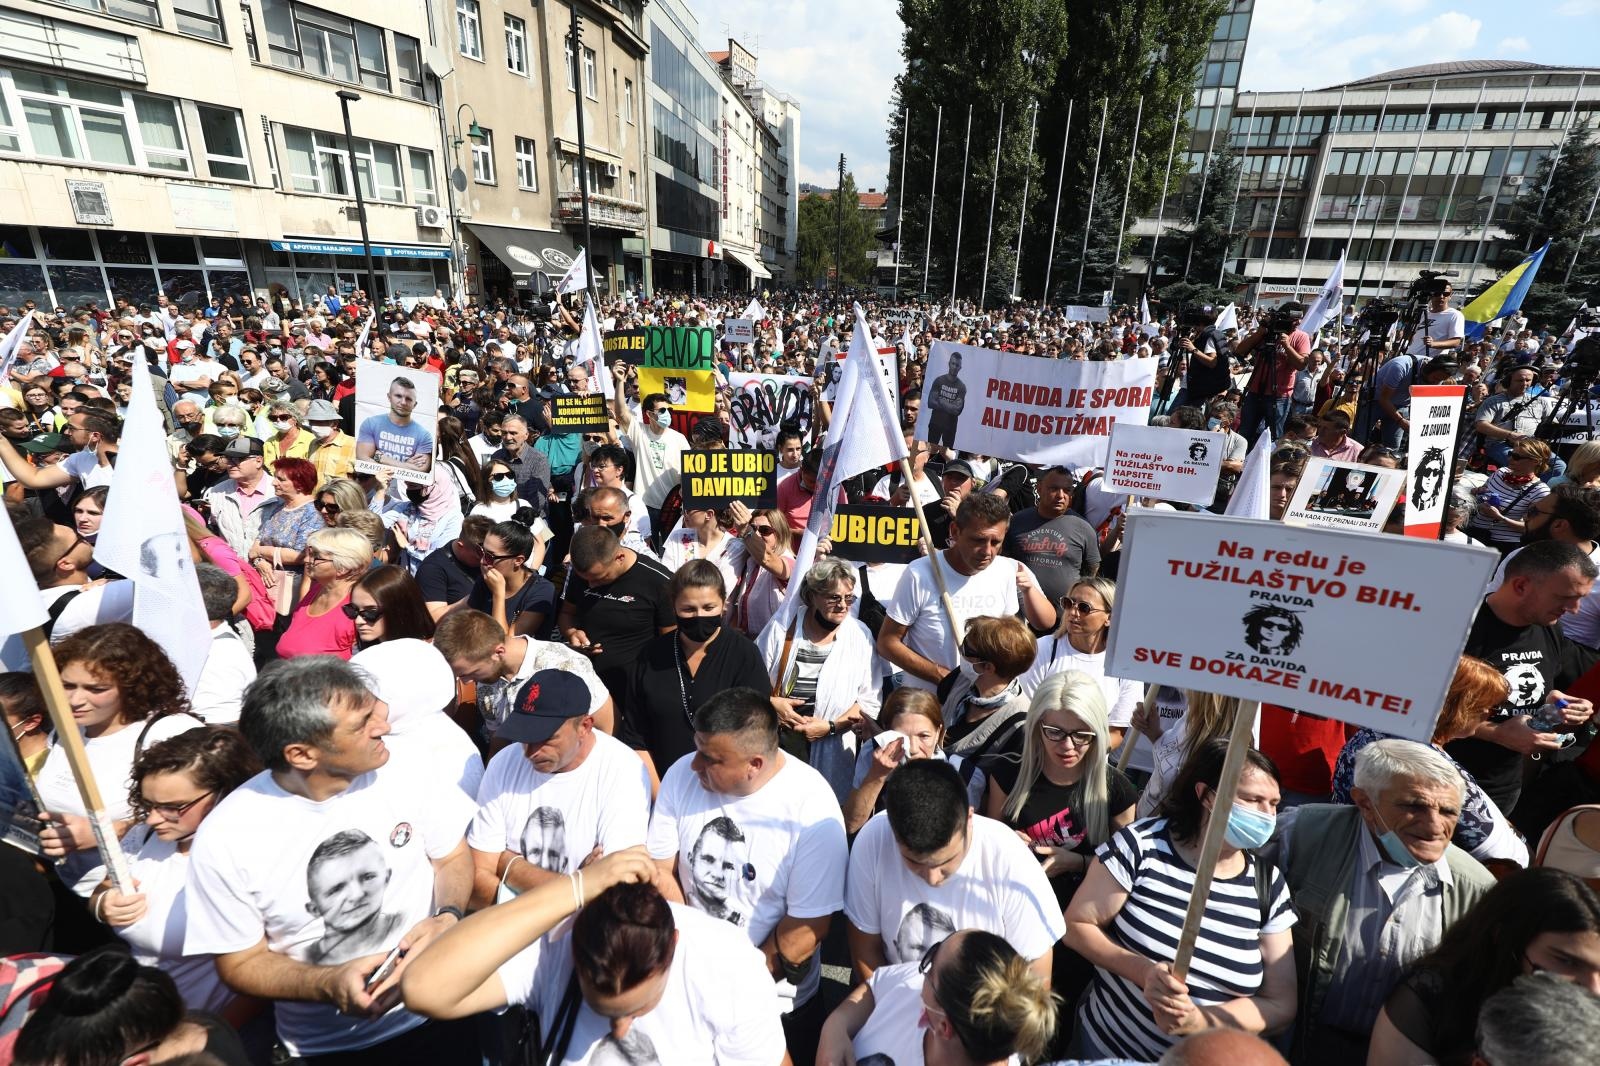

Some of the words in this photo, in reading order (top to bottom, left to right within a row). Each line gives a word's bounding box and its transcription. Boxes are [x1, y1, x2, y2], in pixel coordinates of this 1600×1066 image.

[630, 336, 645, 350] JE!
[986, 378, 1062, 408] PRAVDA
[1066, 389, 1087, 408] JE
[1089, 386, 1153, 408] SPORA
[557, 398, 565, 406] MI
[566, 398, 574, 406] SE
[1429, 405, 1451, 419] PRAVDA
[981, 407, 1010, 430] ALI
[1013, 412, 1116, 436] DOSTIŽNA!
[380, 431, 415, 445] GRAND
[1420, 424, 1429, 437] ZA
[1429, 423, 1451, 437] DAVIDA
[378, 440, 414, 455] FINALS
[683, 453, 706, 473] KO
[710, 453, 728, 473] JE
[731, 453, 775, 473] UBIO
[1115, 450, 1128, 458] Na
[1131, 452, 1151, 460] redu
[1153, 454, 1163, 463] je
[1112, 469, 1154, 480] HAPSITE
[1114, 459, 1174, 473] TUŽILAŠTVO
[1176, 466, 1197, 476] BIH.
[691, 477, 767, 497] DAVIDA?
[1111, 478, 1161, 491] TUŽIOCE!!!
[1290, 510, 1304, 518] DAN
[1304, 513, 1321, 521] KADA
[1333, 517, 1359, 526] PRIZNALI
[830, 513, 920, 546] UBICE!
[1217, 540, 1253, 560] Na
[1263, 549, 1329, 570] redu
[1337, 556, 1366, 576] je
[1167, 559, 1347, 599] TUŽILAŠTVO
[1356, 585, 1422, 612] BIH.
[1249, 589, 1315, 608] PRAVDA
[1224, 650, 1245, 662] ZA
[1250, 655, 1307, 674] DAVIDA
[1502, 651, 1544, 662] PRAVDA
[1133, 647, 1183, 668] SVE
[1189, 655, 1301, 690] DOKAZE
[1308, 678, 1413, 715] IMATE!
